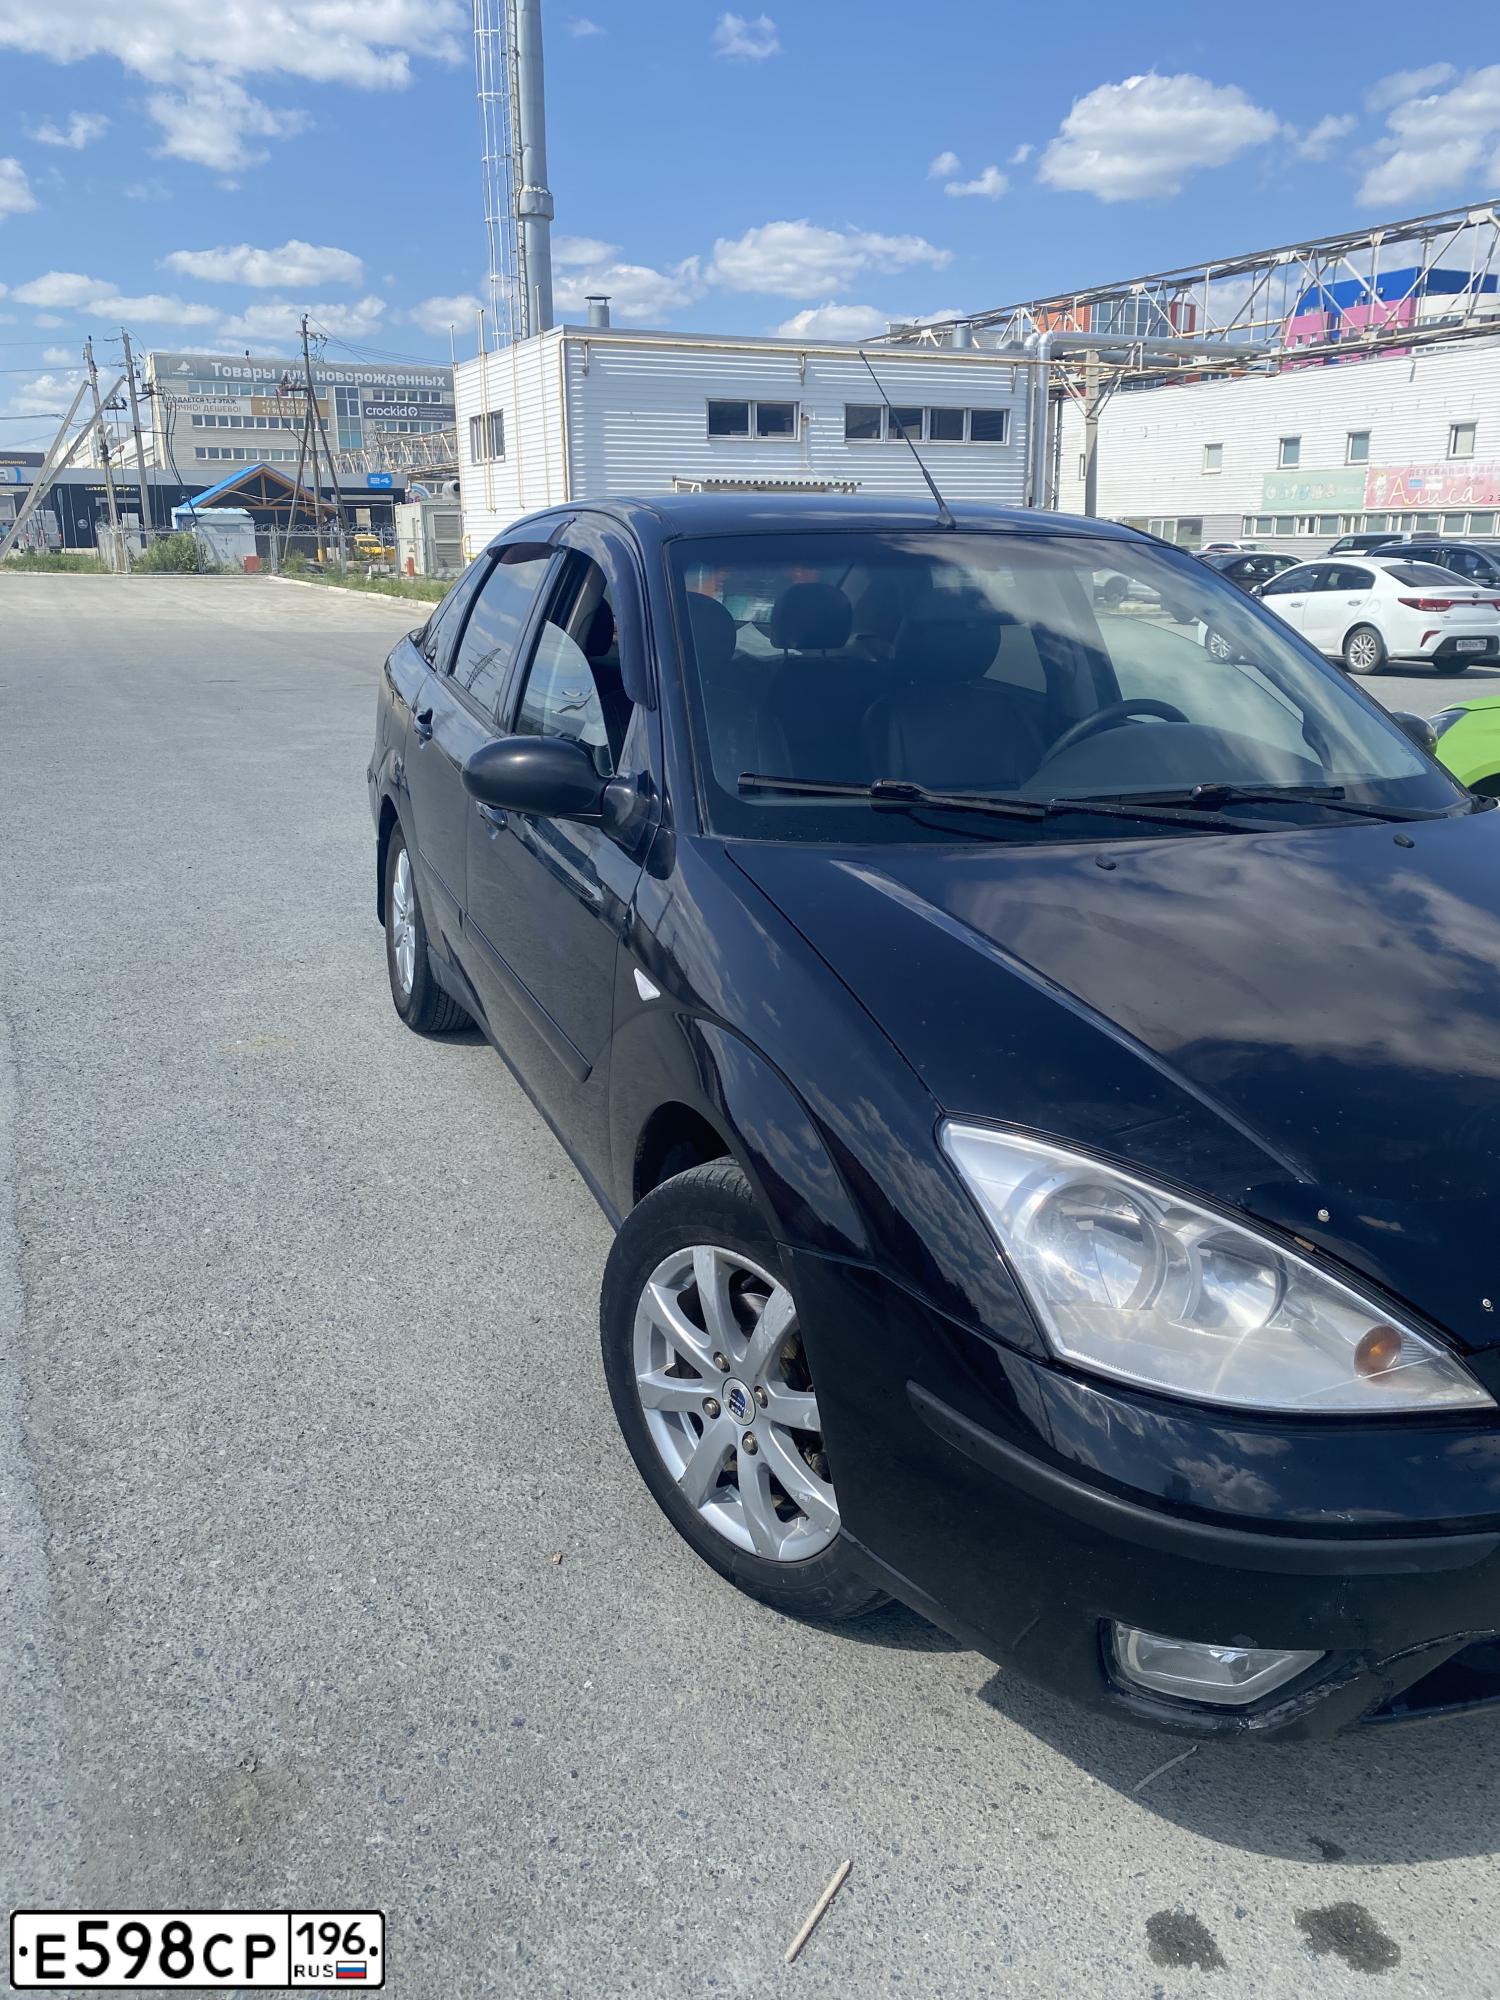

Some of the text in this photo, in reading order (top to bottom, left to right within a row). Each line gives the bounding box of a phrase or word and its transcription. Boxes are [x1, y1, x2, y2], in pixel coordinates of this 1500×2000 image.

[211, 362, 275, 381] Товары
[316, 371, 446, 387] новорожденных
[366, 406, 407, 417] crockid
[1388, 476, 1485, 505] Алиса
